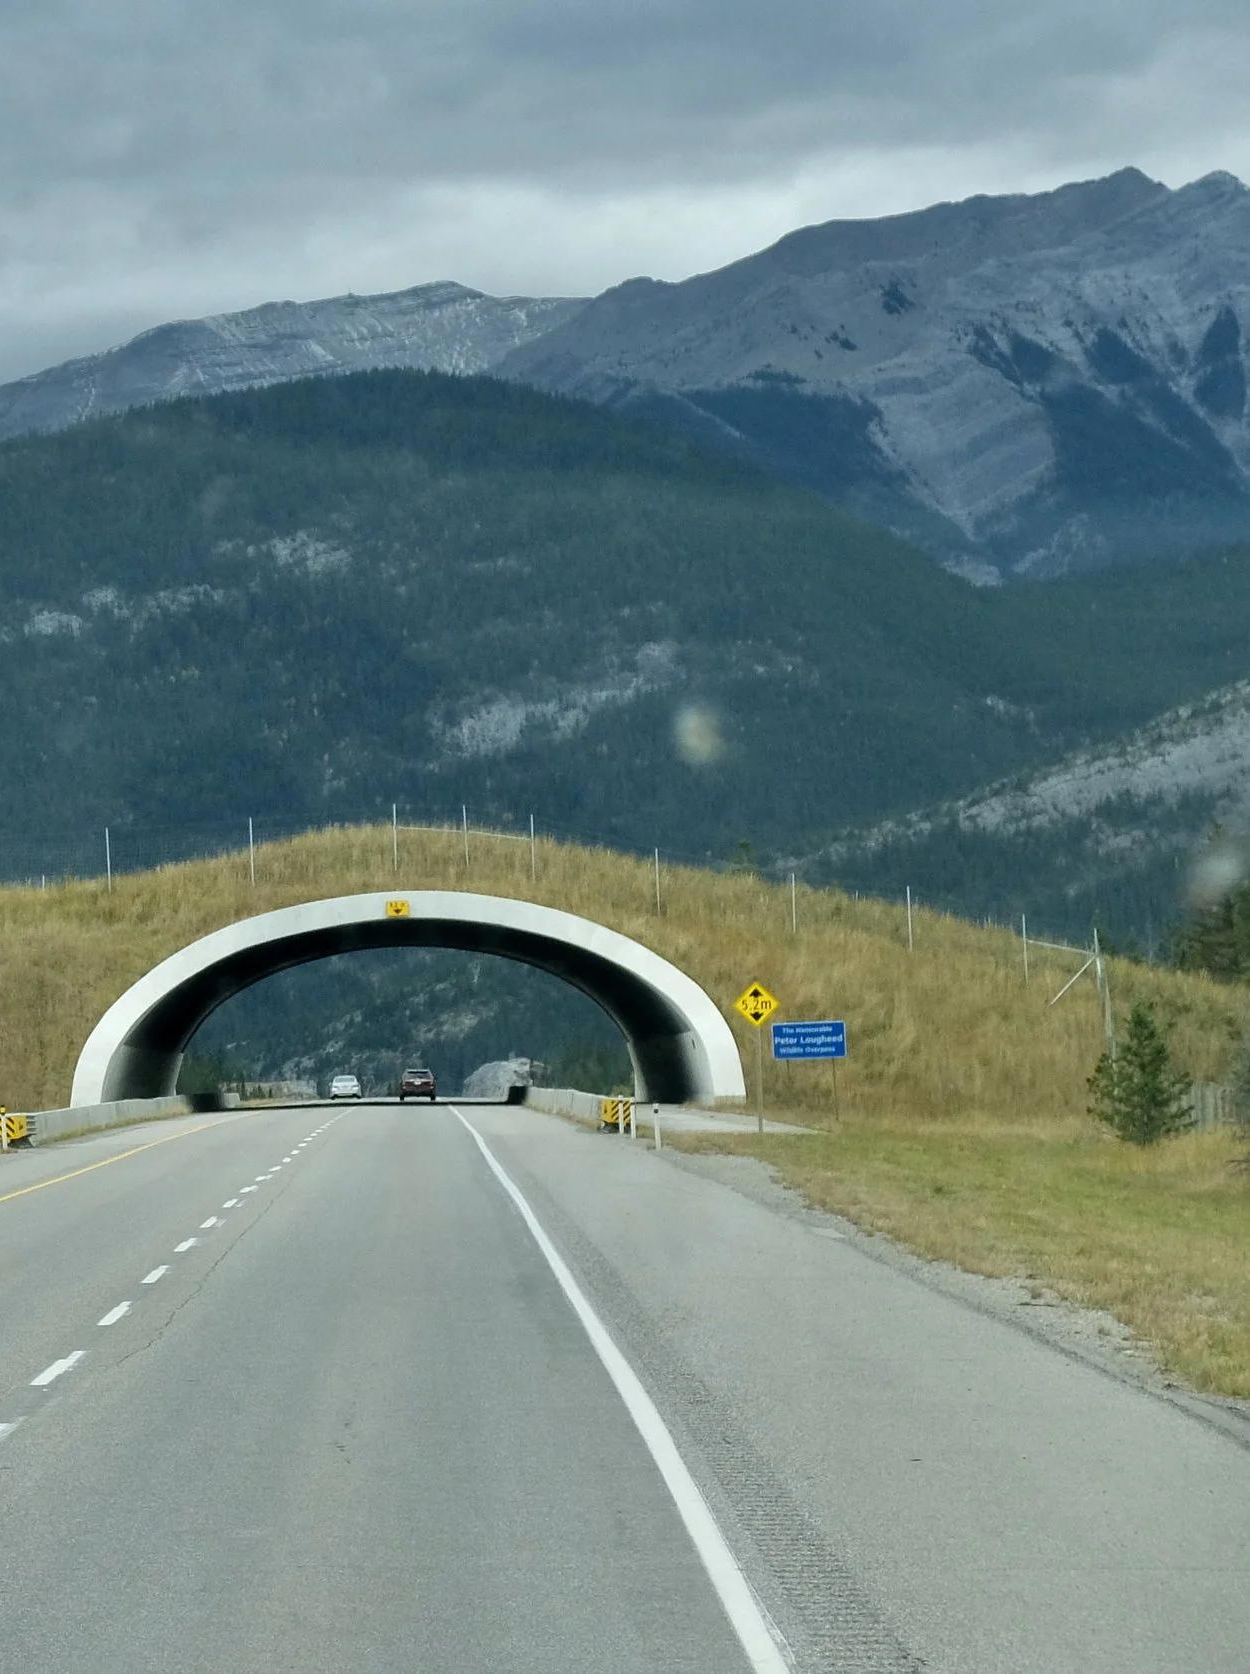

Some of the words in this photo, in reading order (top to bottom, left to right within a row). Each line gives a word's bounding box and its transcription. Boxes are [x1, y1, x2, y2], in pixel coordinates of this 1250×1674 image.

[742, 1000, 771, 1010] 5.2m
[774, 1036, 798, 1044] Peter
[800, 1034, 843, 1045] Lougheed
